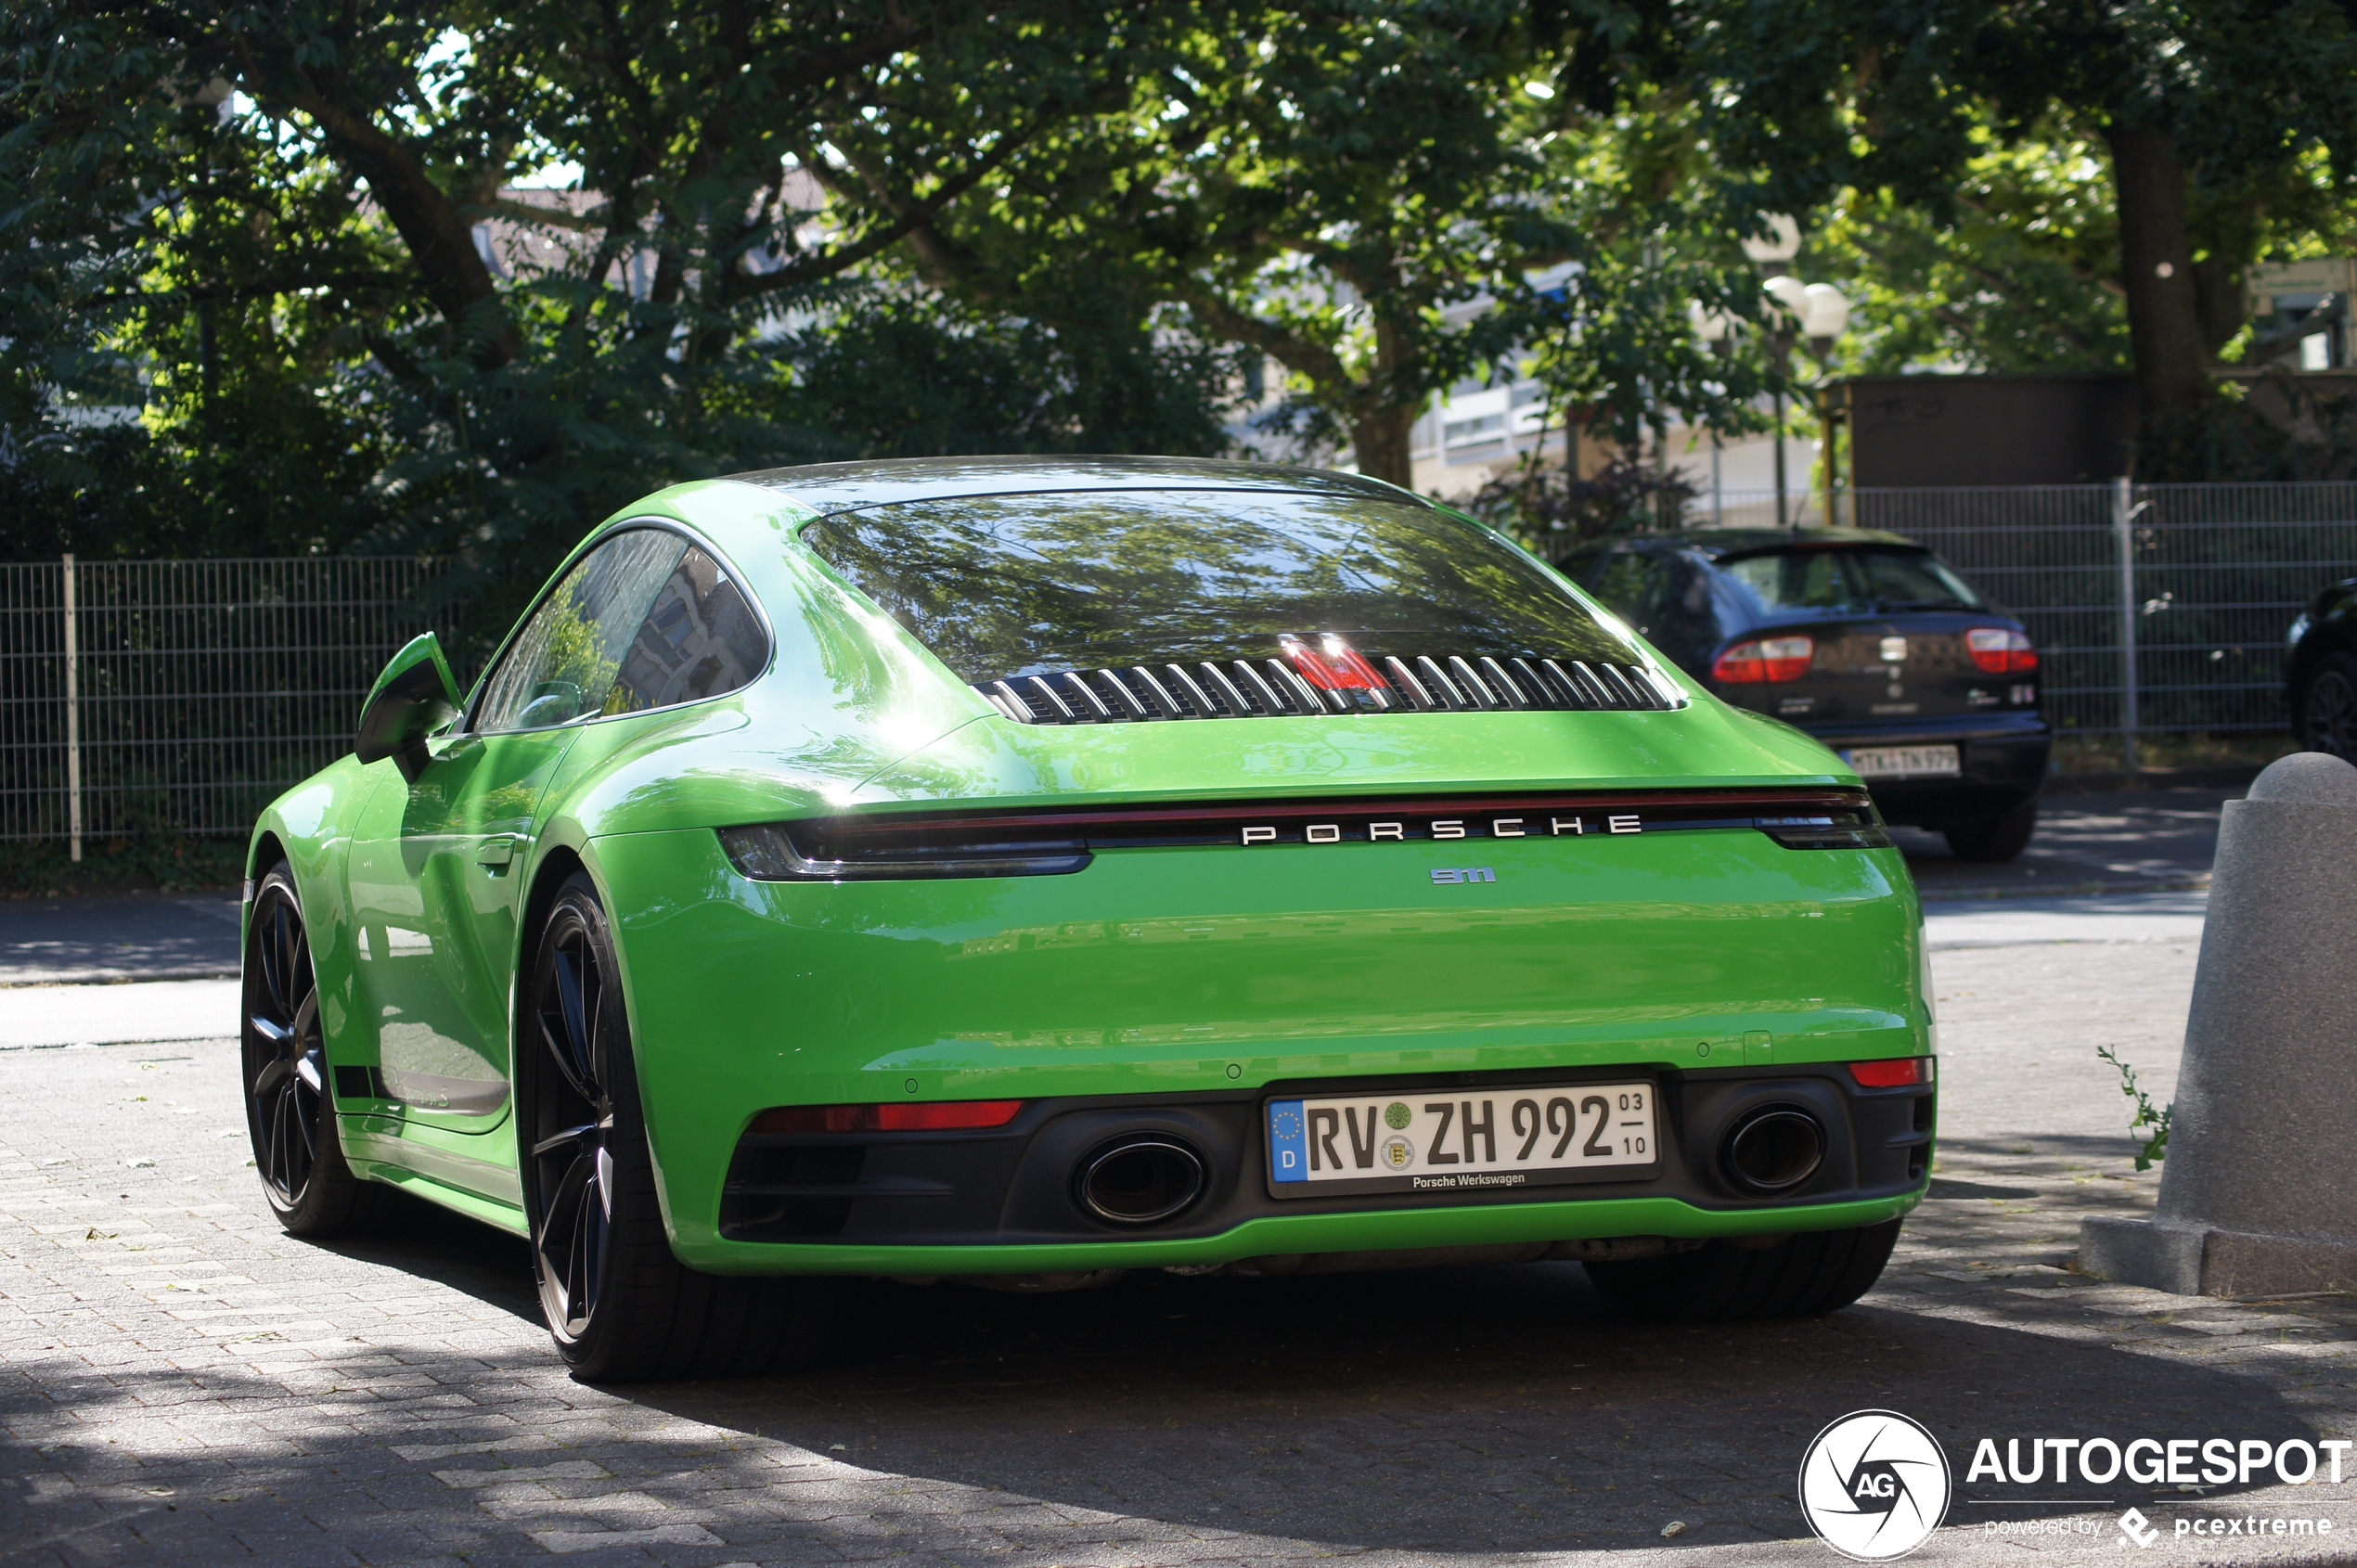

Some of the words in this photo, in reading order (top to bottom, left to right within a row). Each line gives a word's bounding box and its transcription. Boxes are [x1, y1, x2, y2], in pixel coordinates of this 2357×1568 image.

[1242, 815, 1642, 845] PORSCHE
[1429, 867, 1497, 884] 911
[1618, 1093, 1643, 1112] 03
[1307, 1106, 1377, 1171] RV
[1424, 1099, 1497, 1164] ZH
[1511, 1095, 1613, 1161] 992
[1623, 1137, 1646, 1155] 10
[1282, 1150, 1295, 1168] D
[1413, 1175, 1456, 1189] Porsche
[1457, 1172, 1526, 1187] Werkswagen
